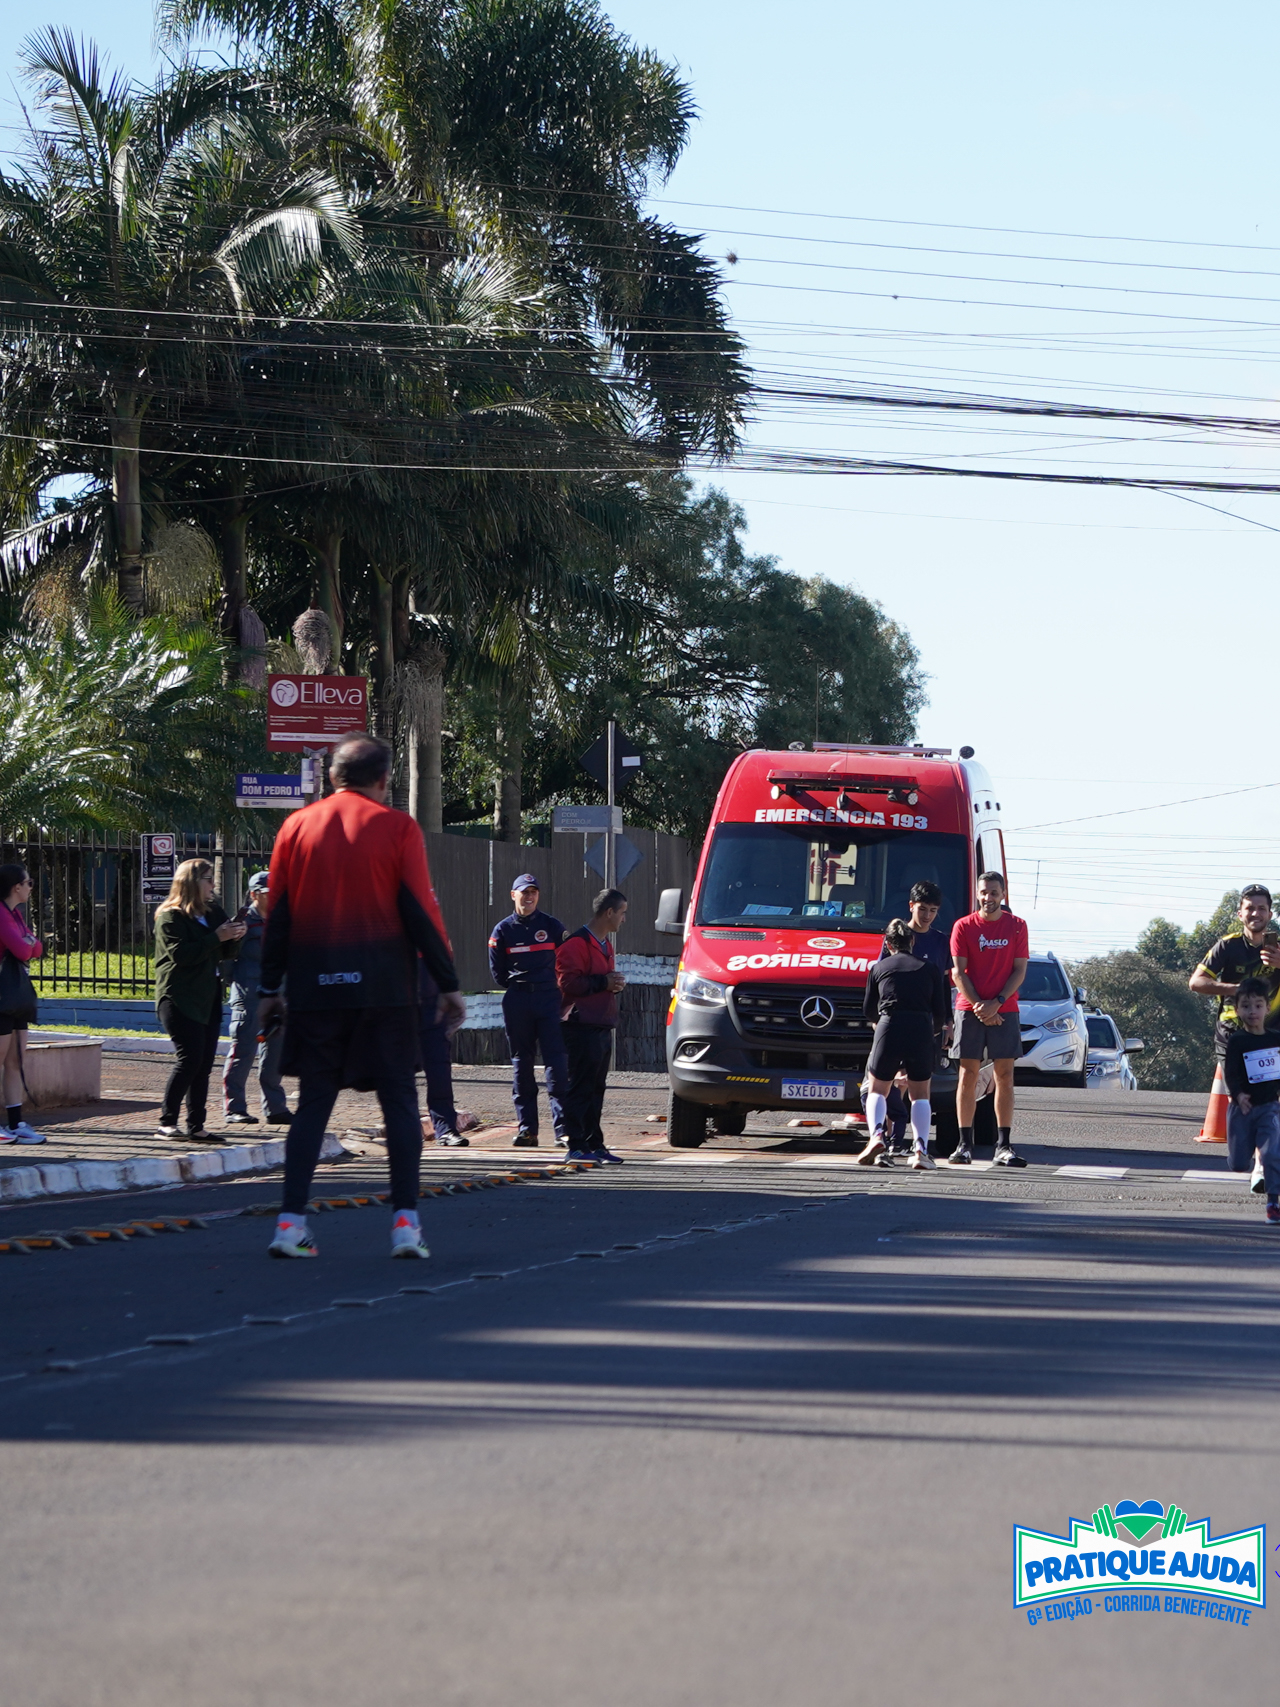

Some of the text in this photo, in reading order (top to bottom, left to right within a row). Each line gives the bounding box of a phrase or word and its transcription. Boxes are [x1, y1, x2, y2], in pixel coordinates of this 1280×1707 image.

[300, 681, 363, 705] Elleva
[242, 776, 258, 784] RUA
[242, 785, 300, 796] DOM PEDRO II
[755, 806, 928, 830] EMERGÊNCIA 193
[318, 971, 362, 986] BUENO
[1258, 1058, 1276, 1068] 039
